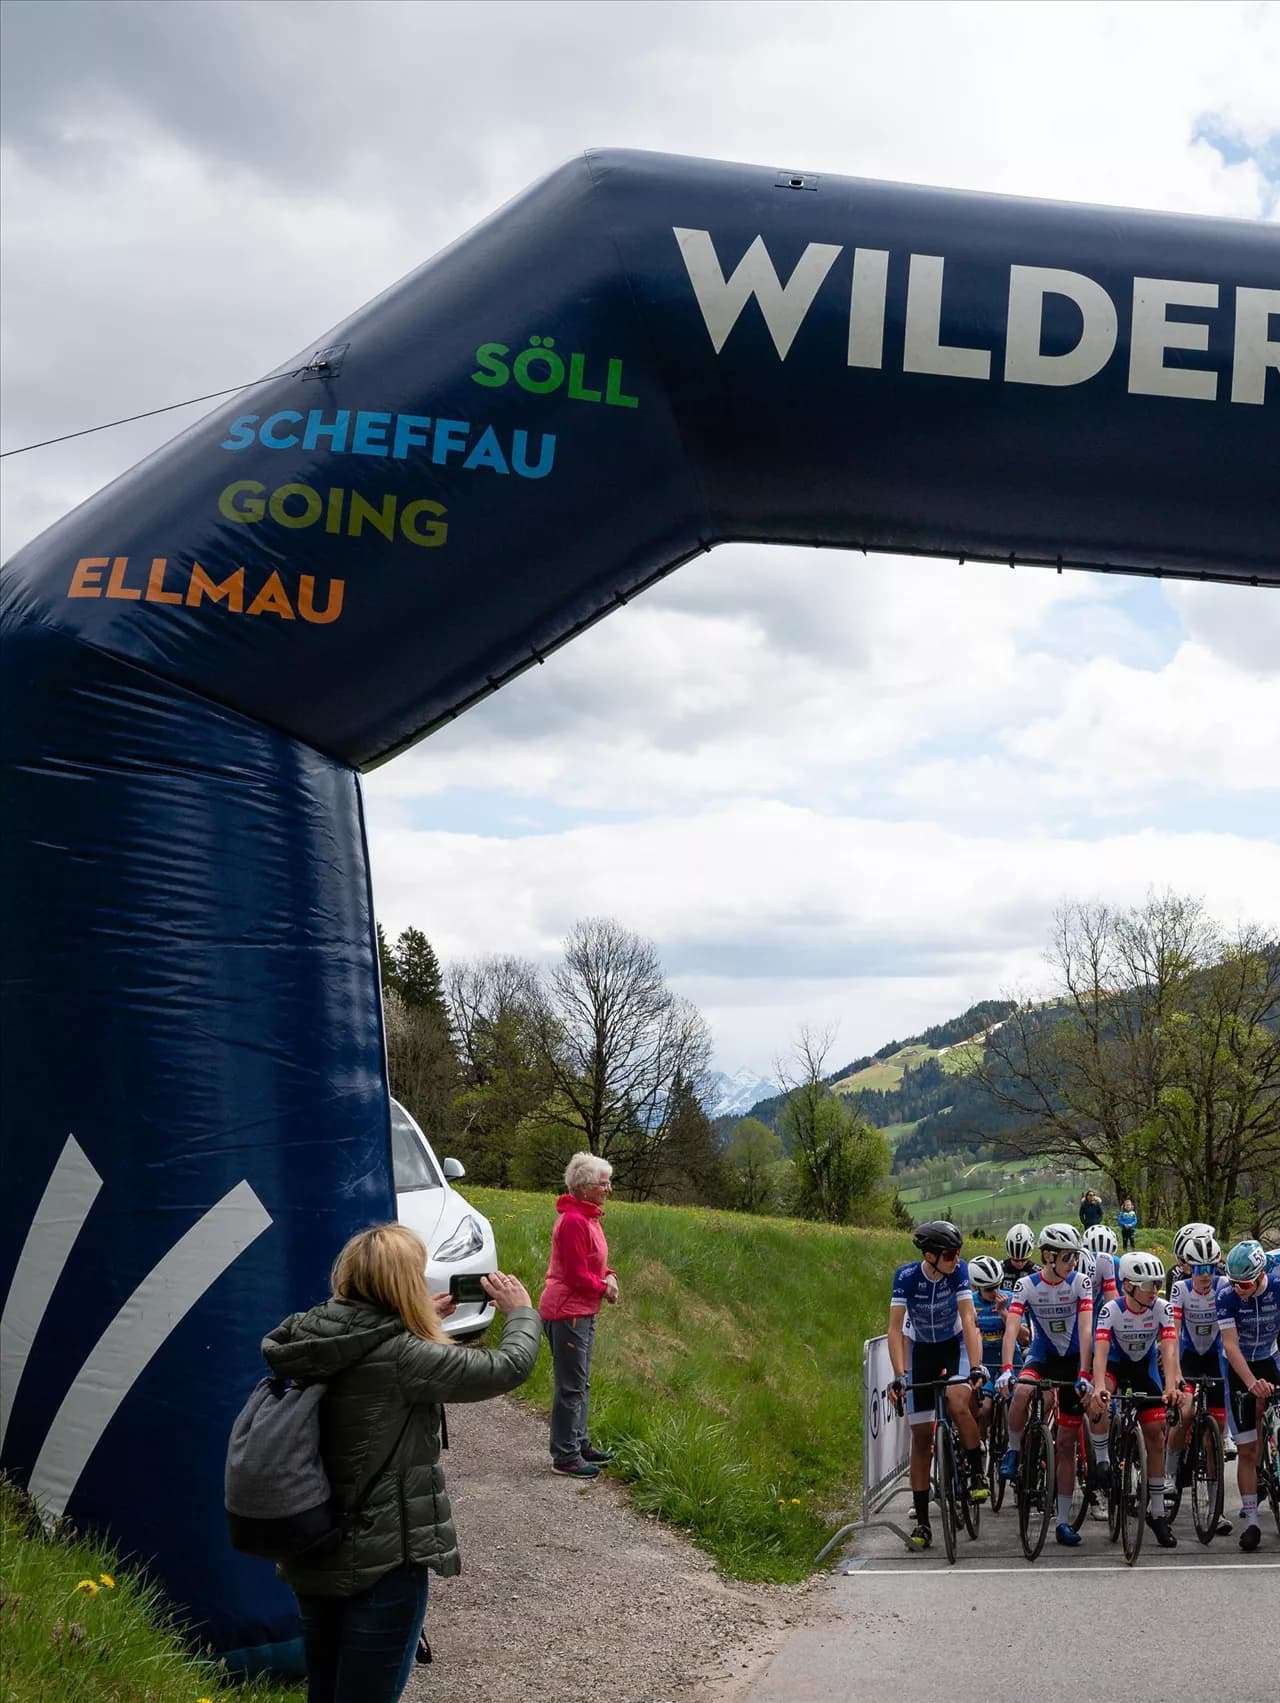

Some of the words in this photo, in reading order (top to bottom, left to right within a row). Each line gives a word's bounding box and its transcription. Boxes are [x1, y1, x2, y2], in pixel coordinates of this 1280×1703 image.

[471, 336, 640, 409] SÖLL
[221, 409, 556, 479] SCHEFFAU
[218, 480, 449, 547] GOING
[67, 556, 345, 624] ELLMAU
